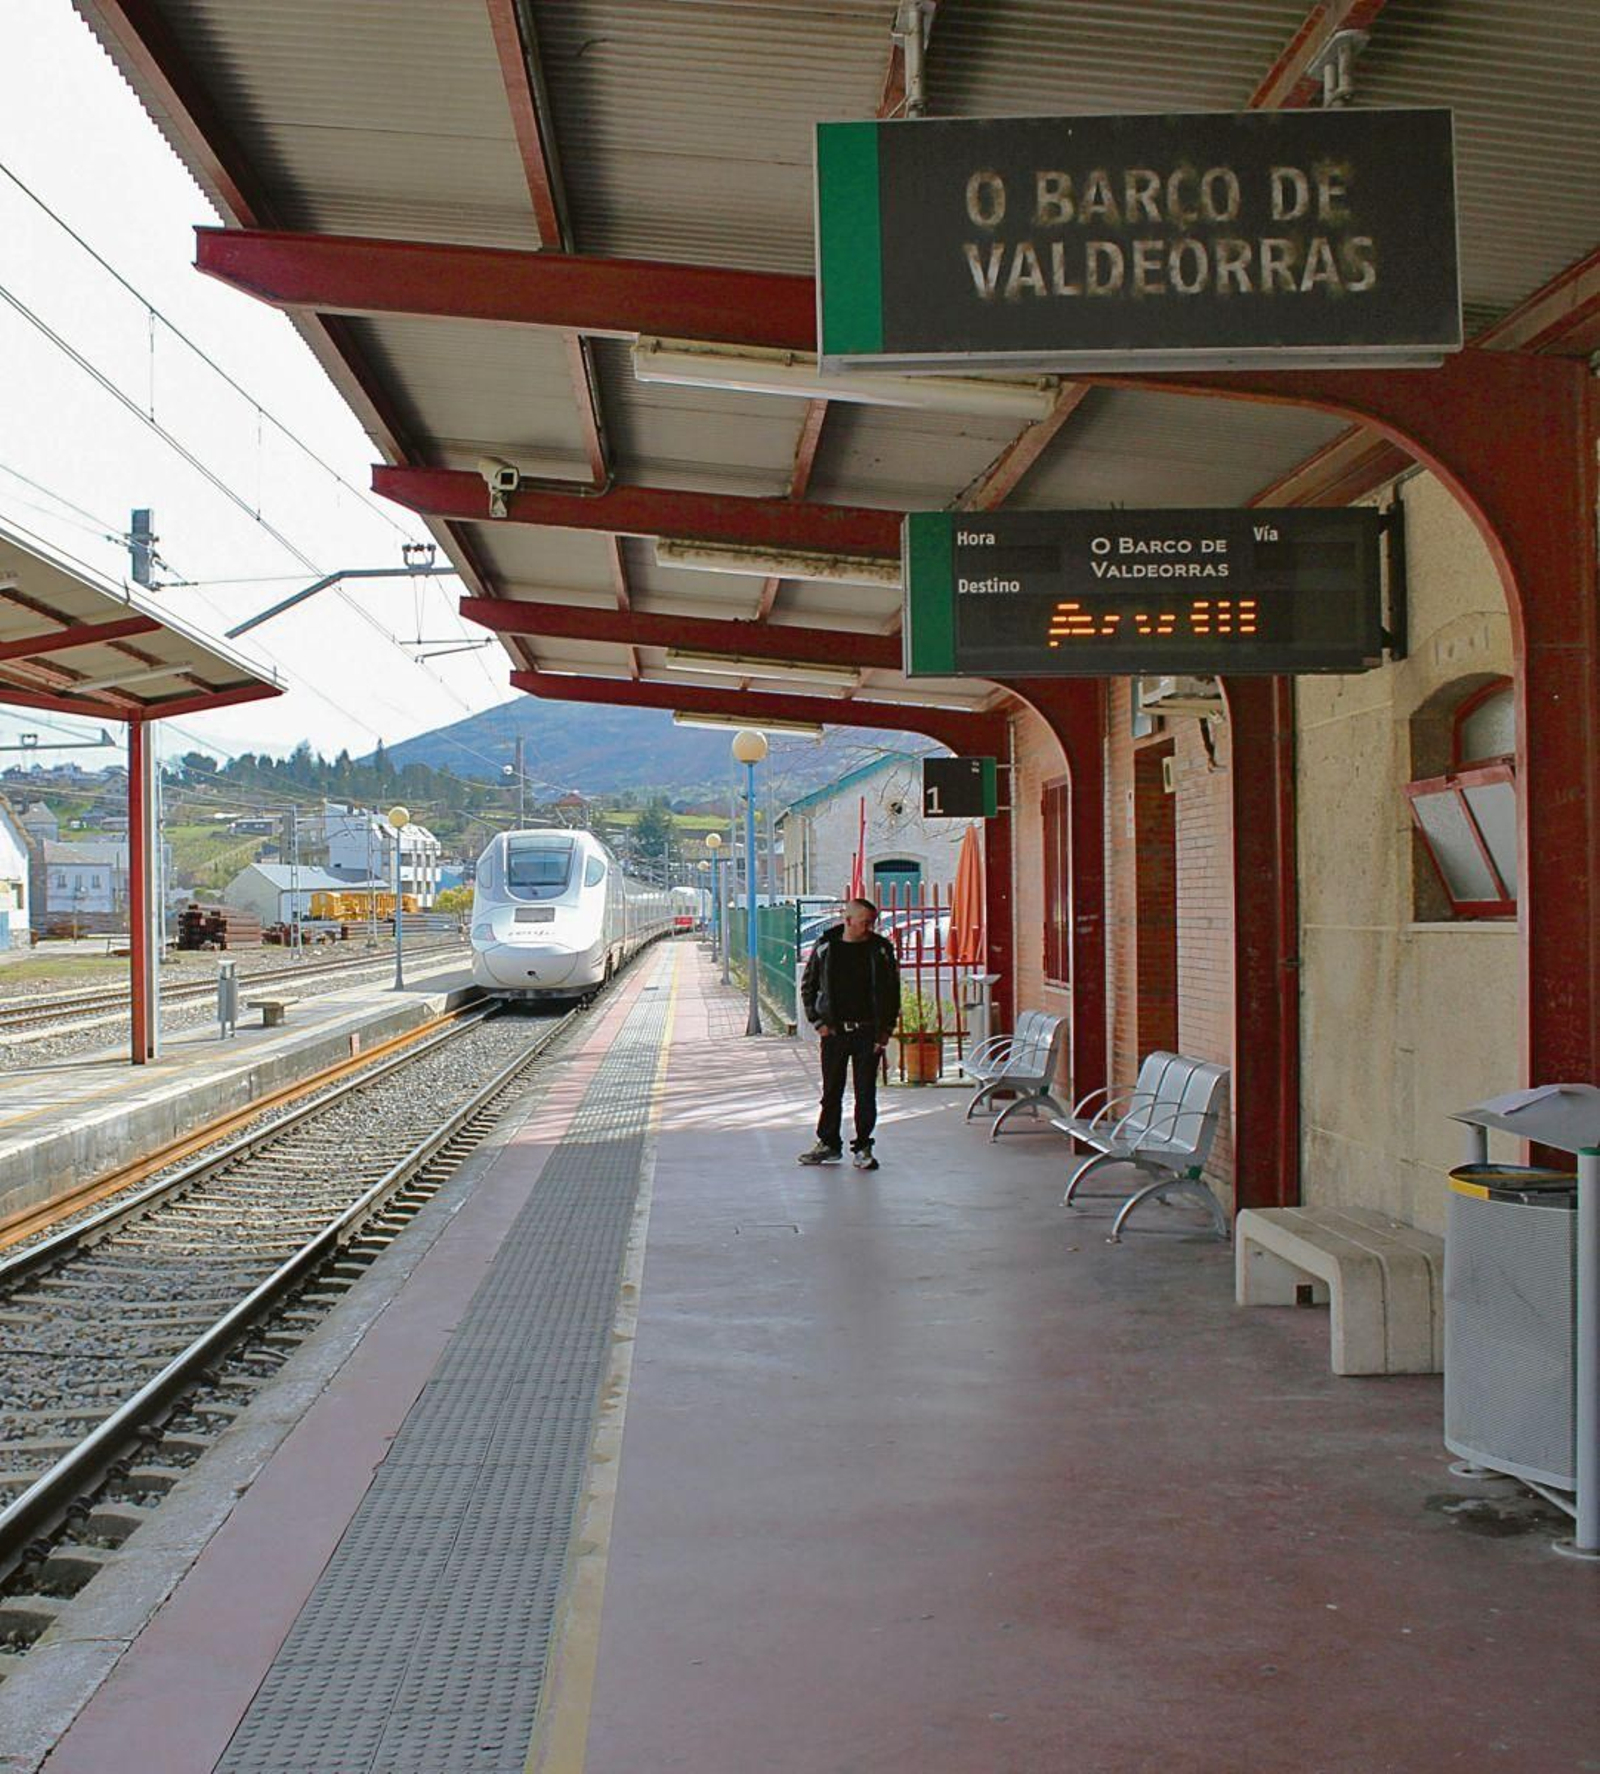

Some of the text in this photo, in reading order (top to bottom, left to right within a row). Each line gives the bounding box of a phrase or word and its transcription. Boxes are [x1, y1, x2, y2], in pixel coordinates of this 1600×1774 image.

[965, 162, 1352, 228] O BARCO DE
[963, 234, 1378, 299] VALDEORRAS
[957, 531, 996, 546] Hora
[1253, 525, 1279, 542] Vía
[1091, 537, 1111, 554] O
[958, 577, 1021, 594] Destino
[926, 786, 944, 814] 1
